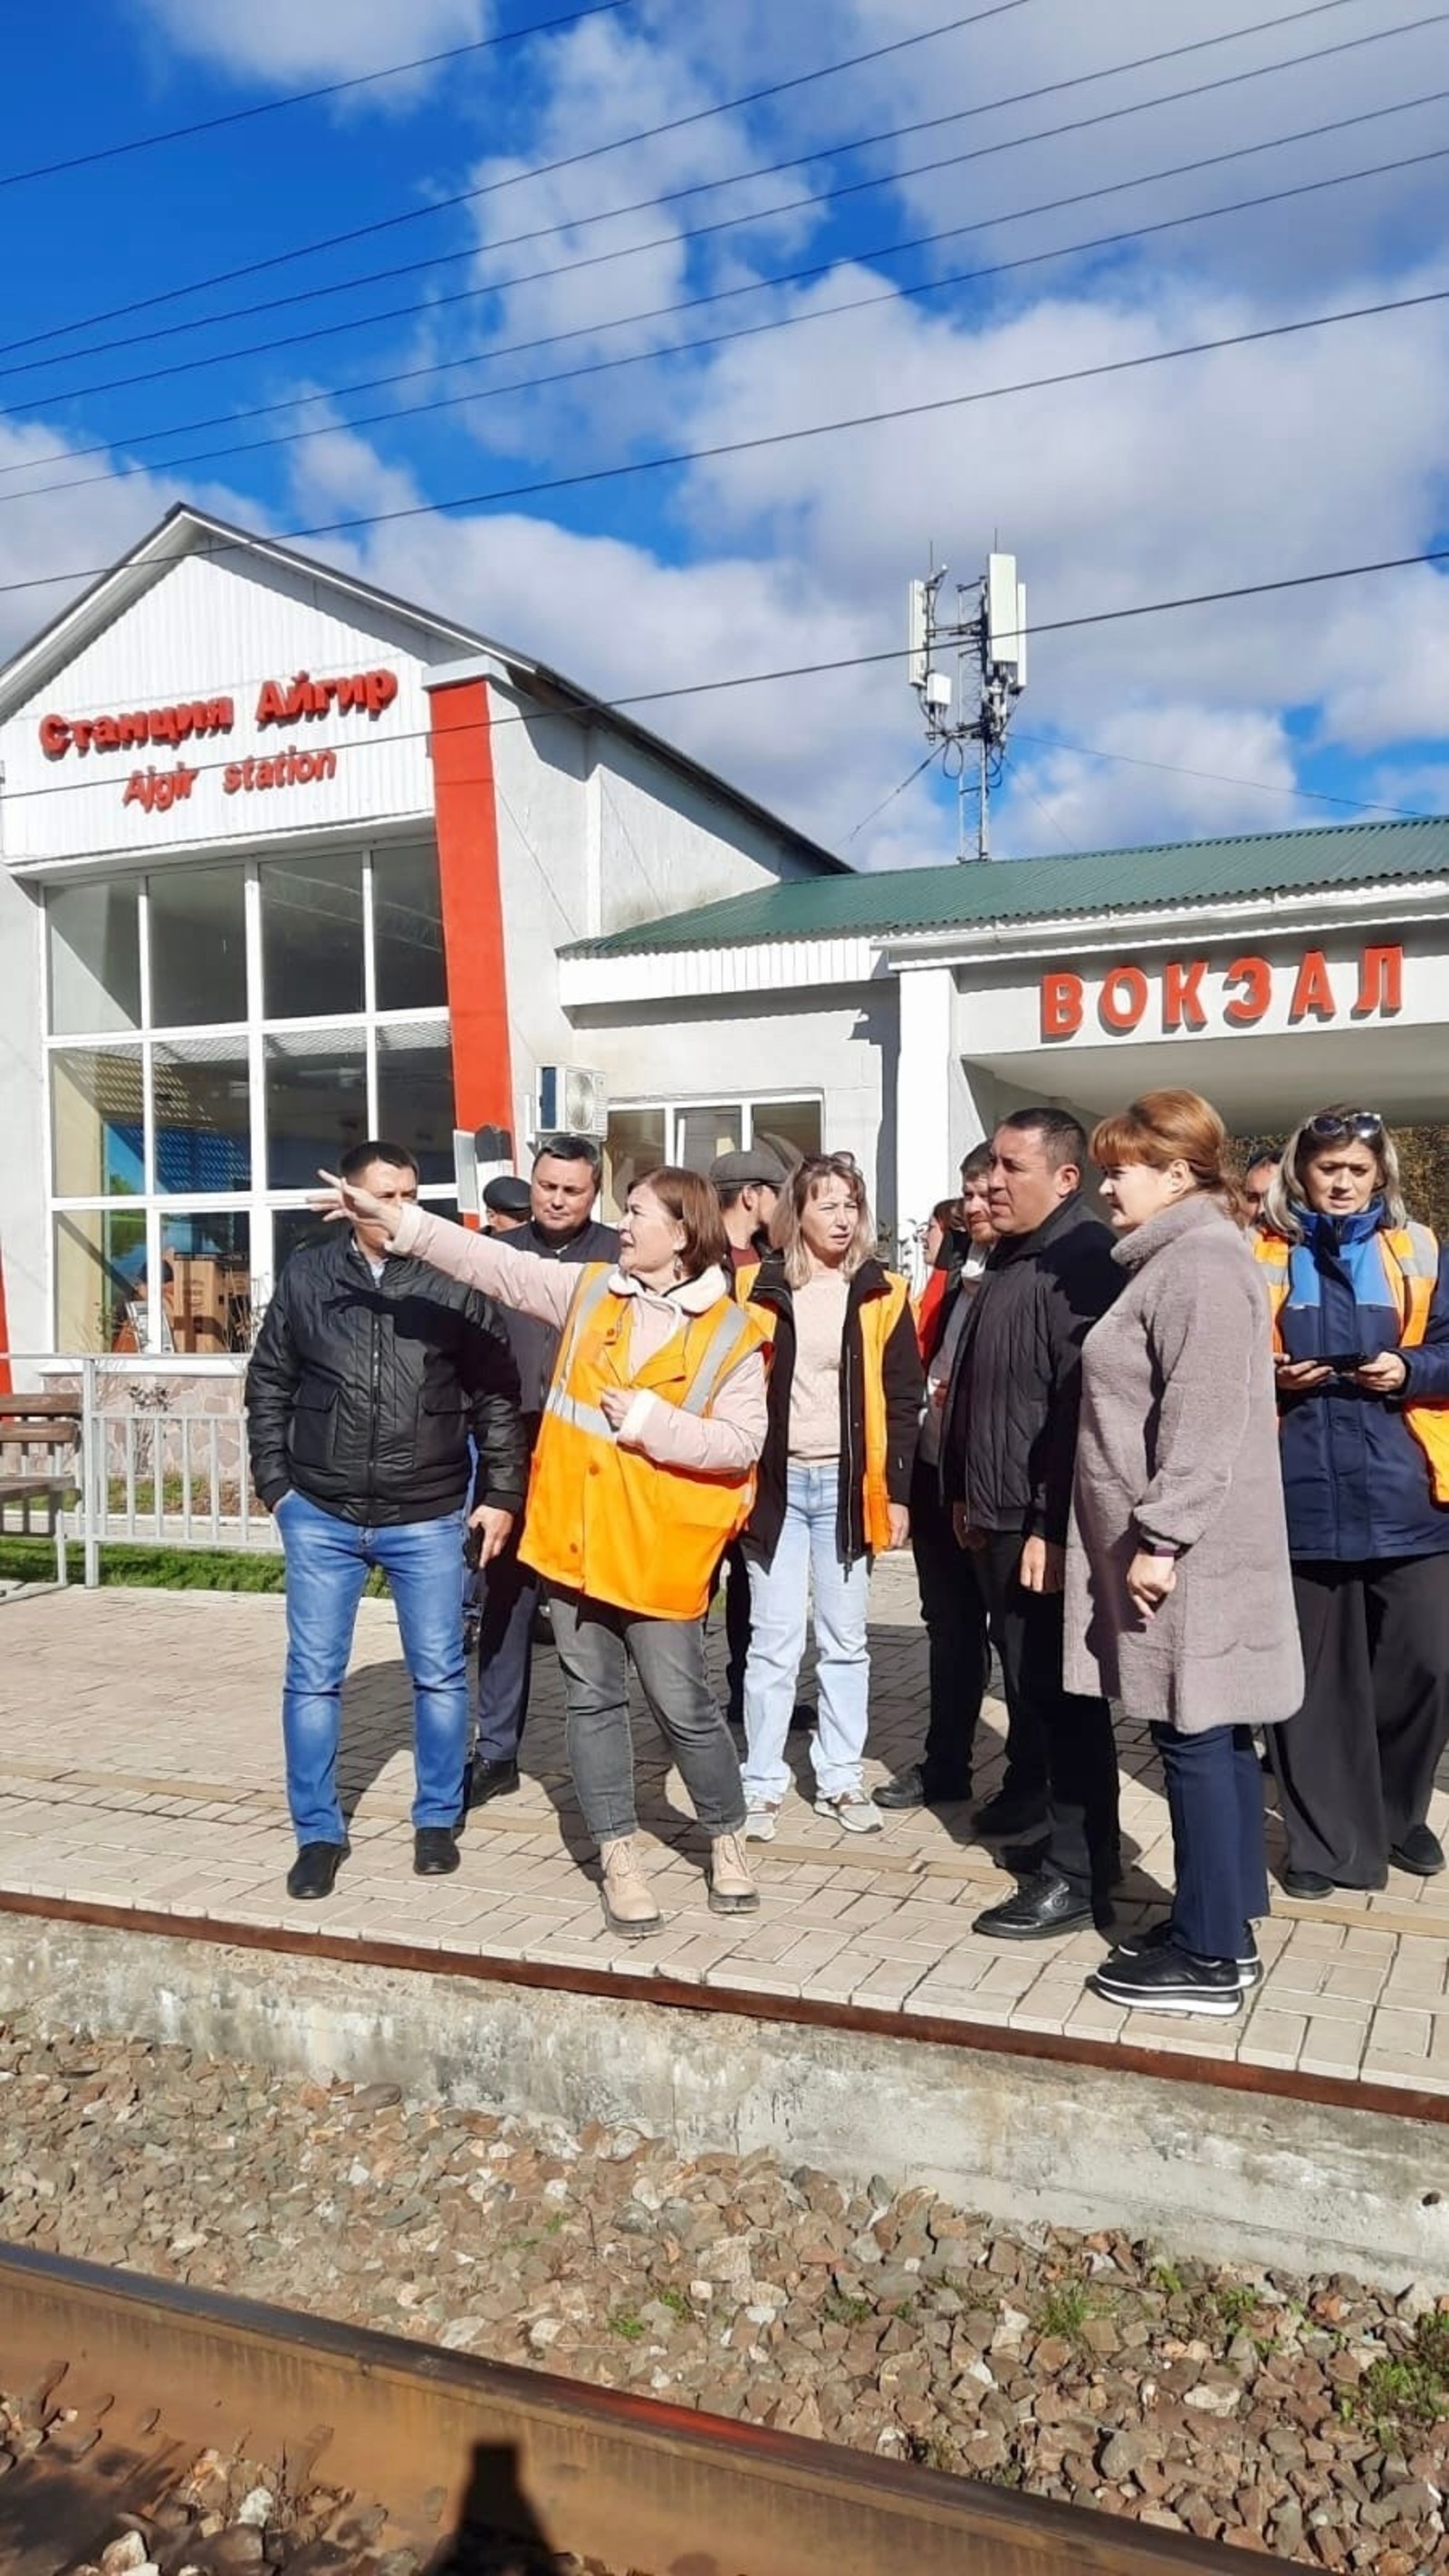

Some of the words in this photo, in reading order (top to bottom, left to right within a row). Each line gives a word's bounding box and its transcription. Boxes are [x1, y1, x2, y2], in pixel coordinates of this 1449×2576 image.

[39, 697, 234, 759] Станция
[255, 668, 398, 729] Айгир
[122, 761, 198, 813] Ajgir
[223, 745, 337, 794] station
[1041, 943, 1404, 1040] ВОКЗАЛ
